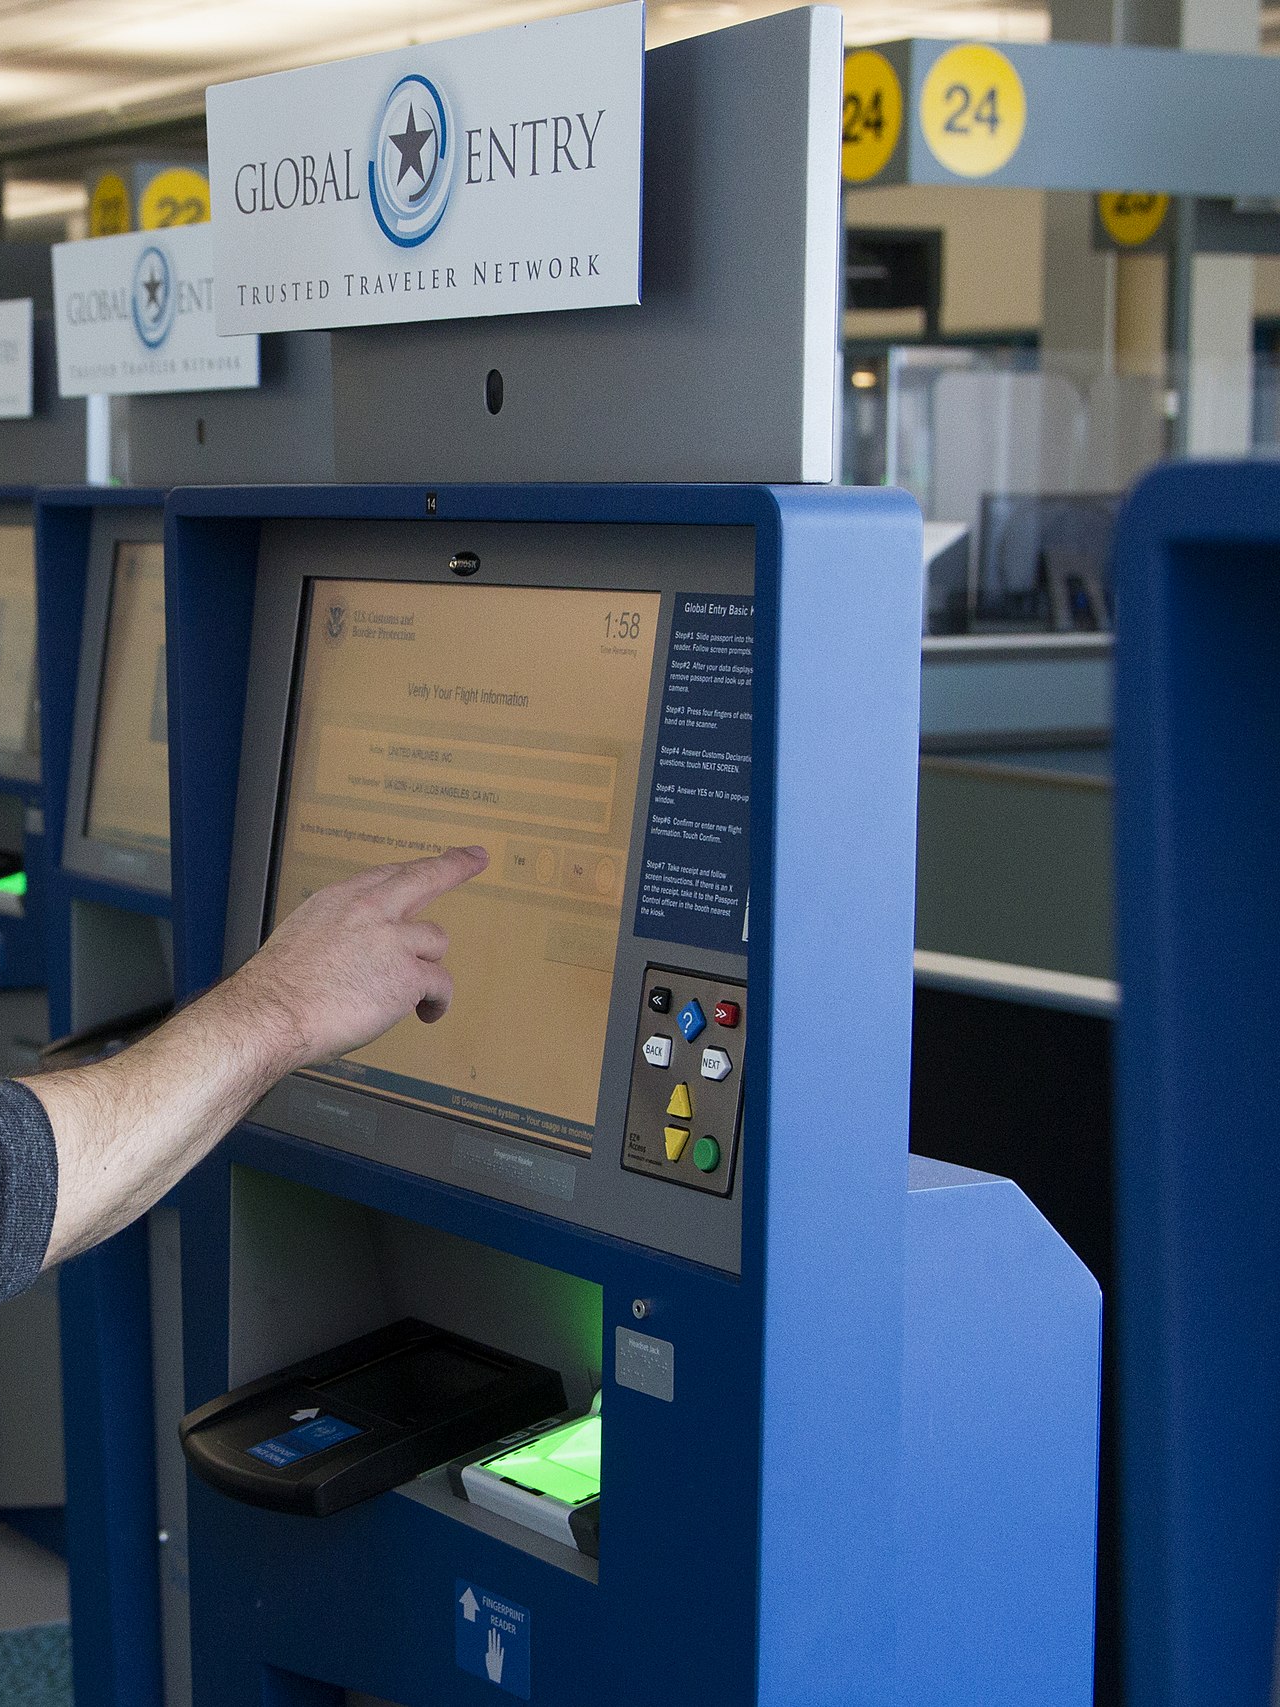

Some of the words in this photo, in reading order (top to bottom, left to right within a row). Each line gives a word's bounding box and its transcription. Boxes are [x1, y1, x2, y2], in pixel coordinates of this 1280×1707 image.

[842, 88, 884, 142] 24
[943, 83, 999, 134] 24
[234, 148, 361, 215] GLOBAL
[465, 109, 606, 185] ENTRY
[66, 287, 132, 326] GLOBAL
[177, 277, 215, 315] ENT
[427, 497, 436, 510] 14
[684, 602, 707, 614] Global
[708, 603, 728, 617] Entry
[729, 604, 749, 616] Basic
[605, 611, 640, 640] 1:58
[674, 630, 694, 641] Step#1
[696, 632, 709, 641] Slide
[710, 634, 733, 643] passport
[734, 634, 744, 643] into
[692, 643, 709, 653] Follow
[710, 646, 727, 654] screen
[671, 660, 691, 670] Step#2
[692, 661, 706, 671] After
[706, 665, 717, 673] your
[718, 664, 731, 673] data
[690, 675, 713, 683] passport
[713, 676, 724, 684] and
[725, 676, 736, 685] look
[408, 682, 430, 701] Verify
[433, 684, 453, 700] Your
[455, 685, 479, 705] Flight
[480, 688, 529, 708] Information
[665, 705, 685, 714] Step#3
[686, 706, 702, 716] Press
[702, 708, 713, 717] four
[713, 709, 732, 719] fingers
[733, 711, 739, 719] of
[664, 717, 678, 726] hand
[686, 719, 695, 727] the
[660, 745, 680, 755] Step#4
[681, 748, 701, 758] Answer
[701, 750, 725, 760] Customs
[686, 760, 701, 769] touch
[701, 761, 717, 771] NEXT
[655, 783, 675, 793] Step#5
[677, 785, 697, 796] Answer
[697, 788, 708, 797] YES
[708, 790, 715, 798] or
[714, 790, 724, 799] NO
[730, 793, 750, 803] pop-up
[652, 814, 671, 825] Step#6
[672, 817, 694, 828] Confirm
[694, 821, 700, 829] or
[700, 822, 715, 831] enter
[727, 824, 742, 835] flight
[682, 830, 698, 840] Touch
[514, 854, 525, 866] Yes
[573, 864, 583, 875] No
[646, 859, 666, 870] Step#7
[667, 862, 680, 872] Take
[680, 866, 699, 876] receipt
[699, 869, 710, 877] and
[710, 869, 727, 879] follow
[644, 873, 663, 881] screen
[699, 880, 714, 890] there
[720, 884, 728, 892] an
[728, 884, 734, 893] X
[643, 884, 651, 892] on
[651, 884, 660, 893] the
[680, 889, 693, 898] take
[704, 893, 714, 902] the
[714, 894, 739, 906] Passport
[640, 906, 650, 915] the
[642, 895, 661, 905] Control
[661, 898, 678, 908] officer
[684, 901, 694, 910] the
[694, 903, 710, 913] booth
[710, 907, 731, 917] nearest
[645, 1044, 663, 1057] BACK
[703, 1058, 720, 1070] NEXT
[451, 1095, 461, 1106] US
[461, 1097, 497, 1116] Government
[498, 1108, 520, 1121] system
[526, 1114, 541, 1127] Your
[541, 1120, 561, 1134] usage
[482, 1595, 525, 1623] FINGERPRINT
[490, 1614, 517, 1635] READER
